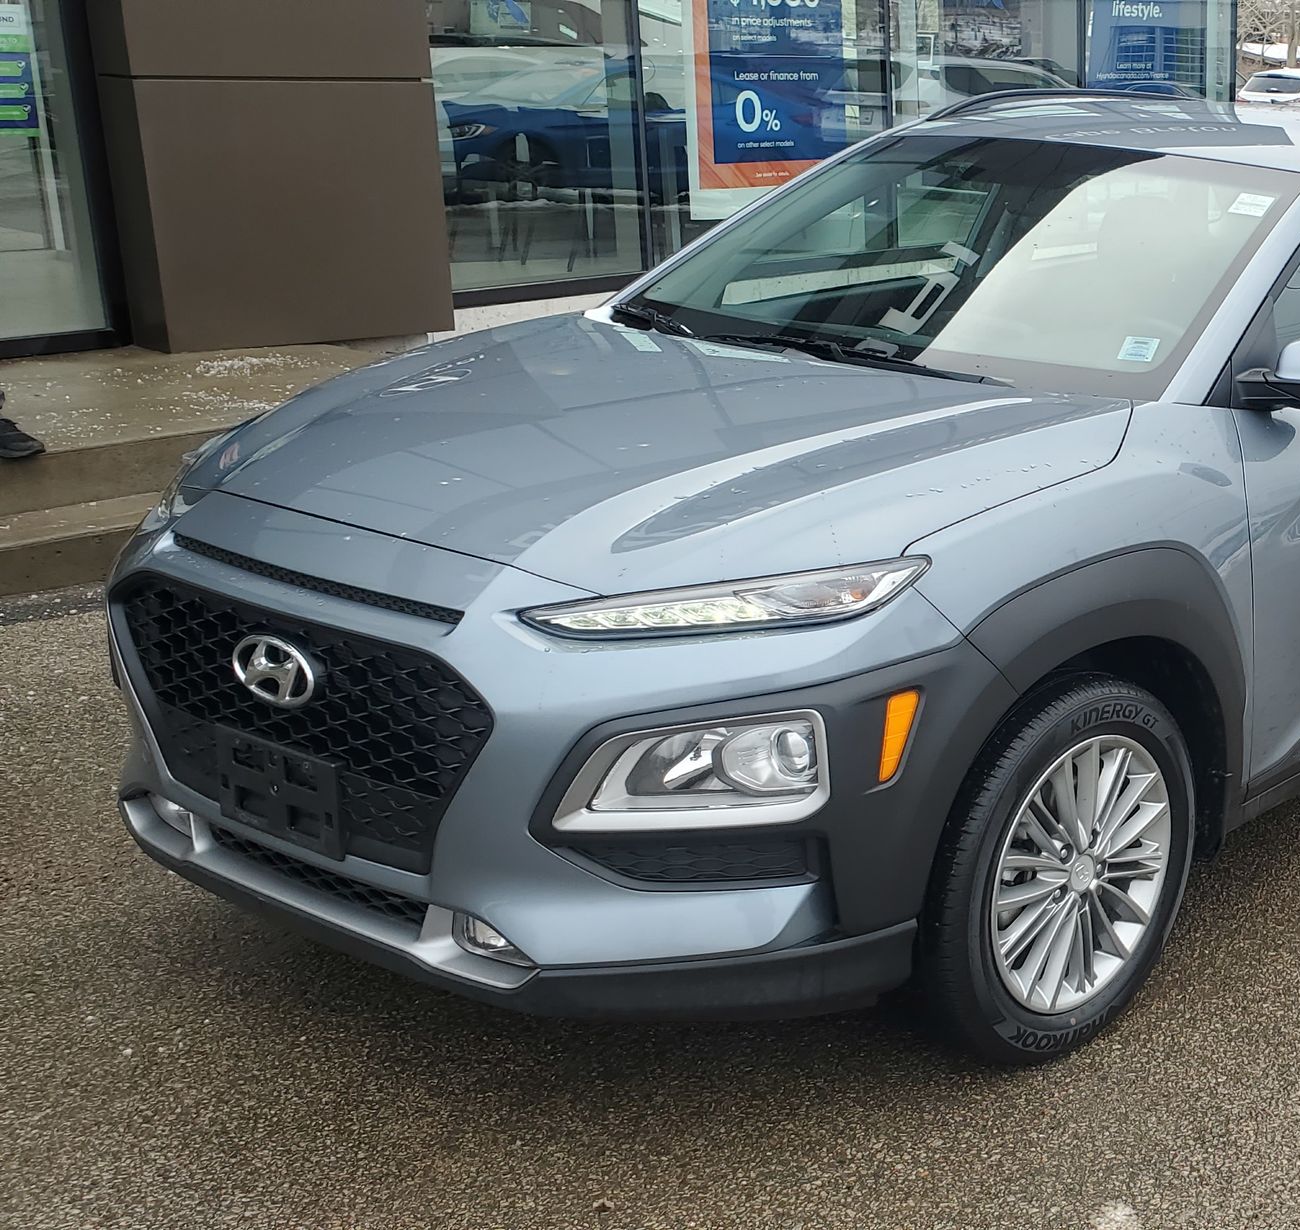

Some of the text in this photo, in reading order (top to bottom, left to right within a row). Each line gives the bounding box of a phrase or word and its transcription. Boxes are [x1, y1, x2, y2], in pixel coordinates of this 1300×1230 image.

[1112, 0, 1163, 20] lifestyle.
[731, 17, 813, 28] in price adjustments
[734, 70, 819, 80] Lease or finance from
[735, 90, 780, 133] 0%
[760, 140, 775, 148] select
[1071, 702, 1159, 735] KINERGY GT
